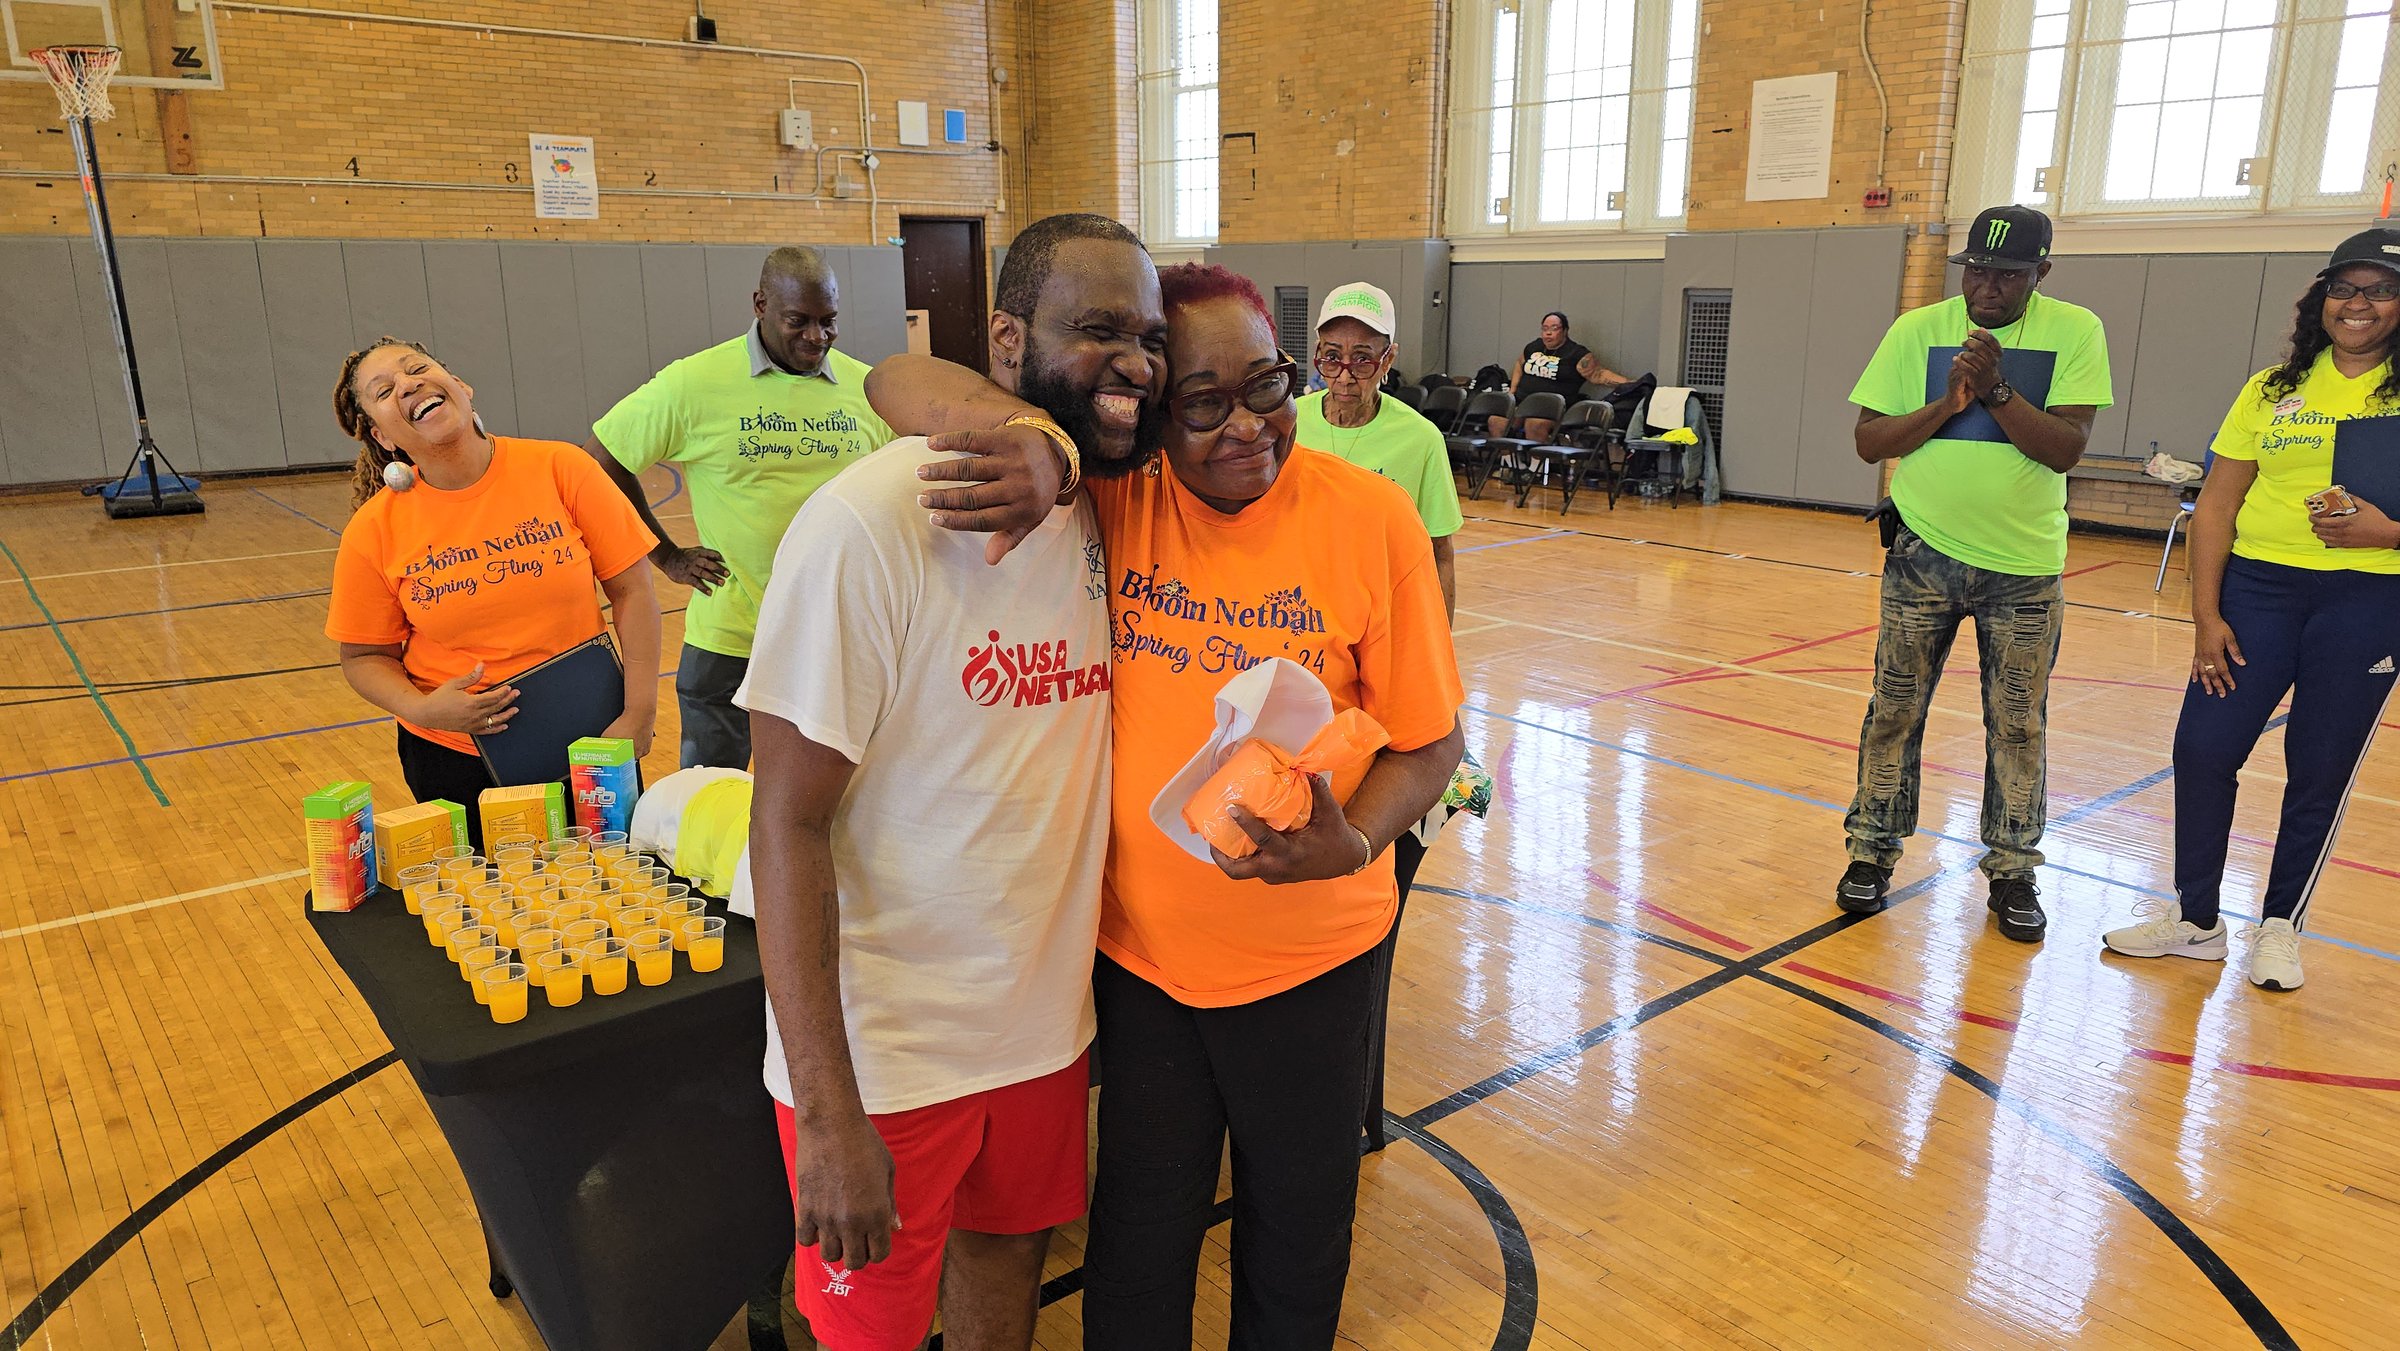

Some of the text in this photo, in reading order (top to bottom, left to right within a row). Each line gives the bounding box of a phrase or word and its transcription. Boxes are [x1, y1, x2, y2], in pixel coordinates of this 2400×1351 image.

[344, 156, 360, 177] 4
[504, 162, 519, 183] 3
[644, 169, 658, 187] 2
[802, 412, 858, 433] Netball
[744, 435, 793, 460] Spring
[797, 437, 840, 459] Fling
[2269, 428, 2324, 451] Spring
[482, 519, 565, 557] Netball
[415, 576, 478, 604] Spring
[482, 558, 544, 584] Fling
[1213, 592, 1327, 633] Netball
[1114, 610, 1192, 674] Spring
[1199, 635, 1274, 674] Flin
[1016, 639, 1068, 677] USA
[821, 1281, 855, 1297] FBT
